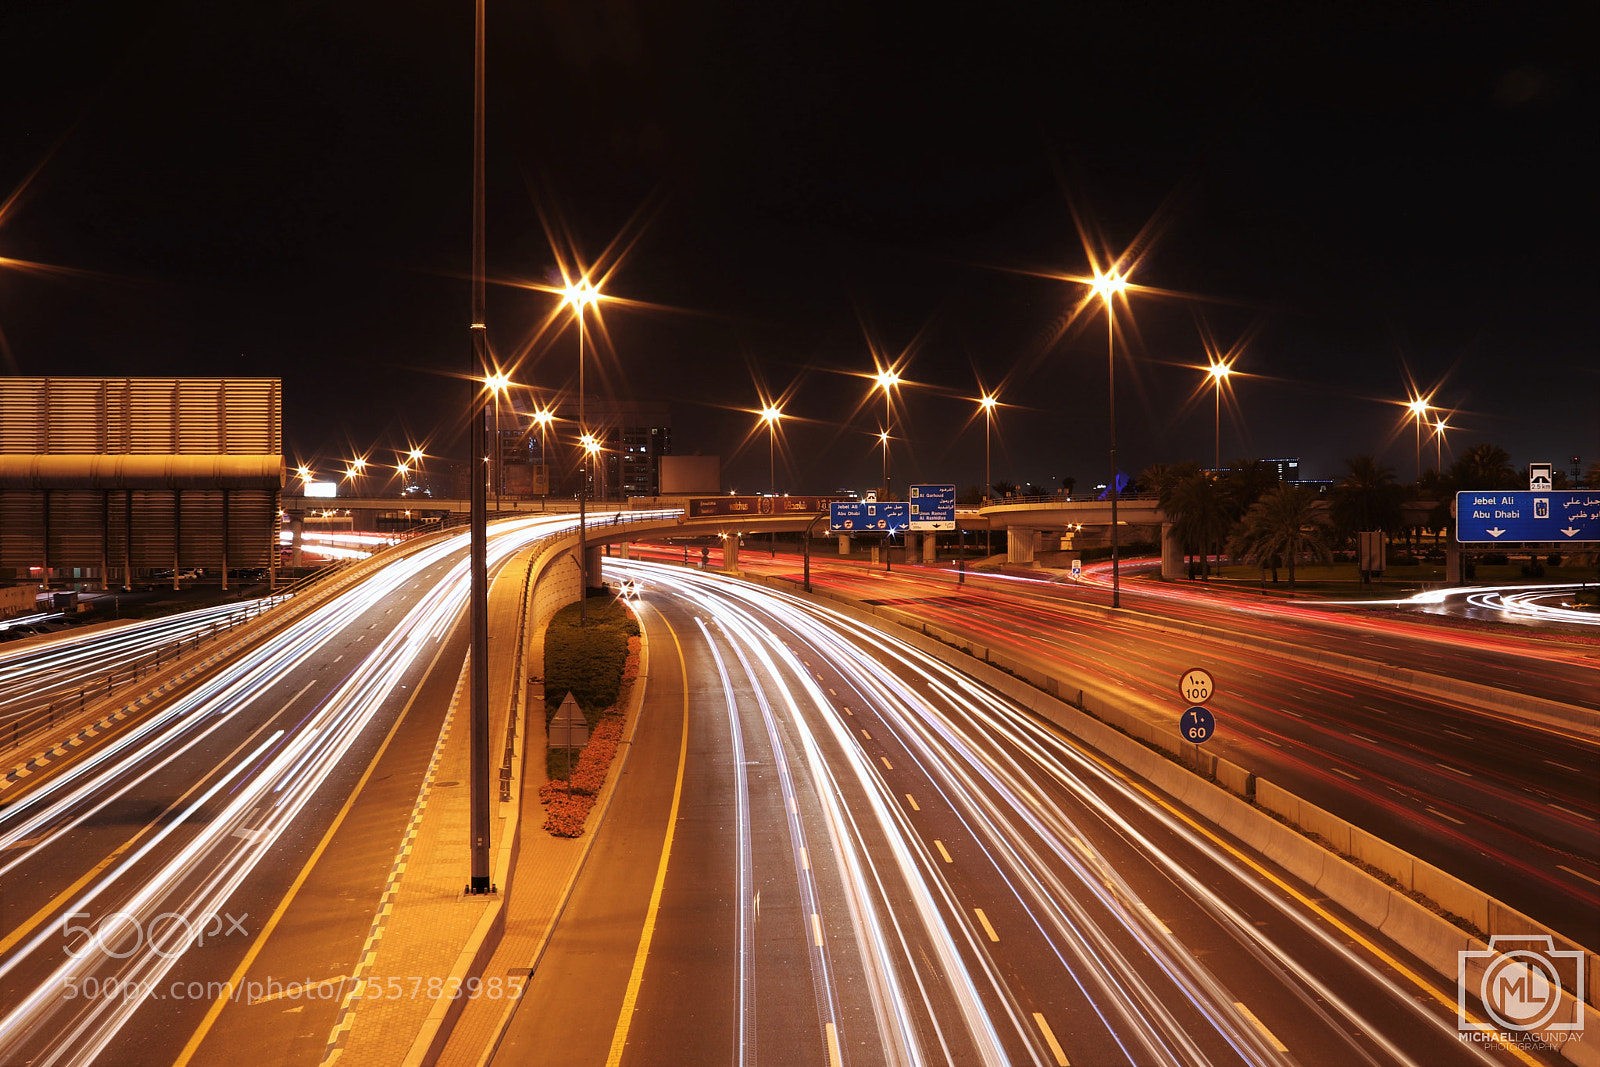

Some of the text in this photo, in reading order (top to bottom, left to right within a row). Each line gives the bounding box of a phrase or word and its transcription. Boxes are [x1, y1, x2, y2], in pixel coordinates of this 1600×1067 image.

[1472, 497, 1514, 505] Jebel Ali
[1562, 497, 1580, 509] علي
[1472, 510, 1520, 519] Abu Dhabi
[1538, 508, 1545, 516] 11
[1568, 510, 1588, 522] ظبي
[1189, 675, 1205, 686] ١٠٠
[1186, 688, 1208, 699] 100
[1190, 712, 1205, 724] ٦٠
[1188, 727, 1206, 739] 60
